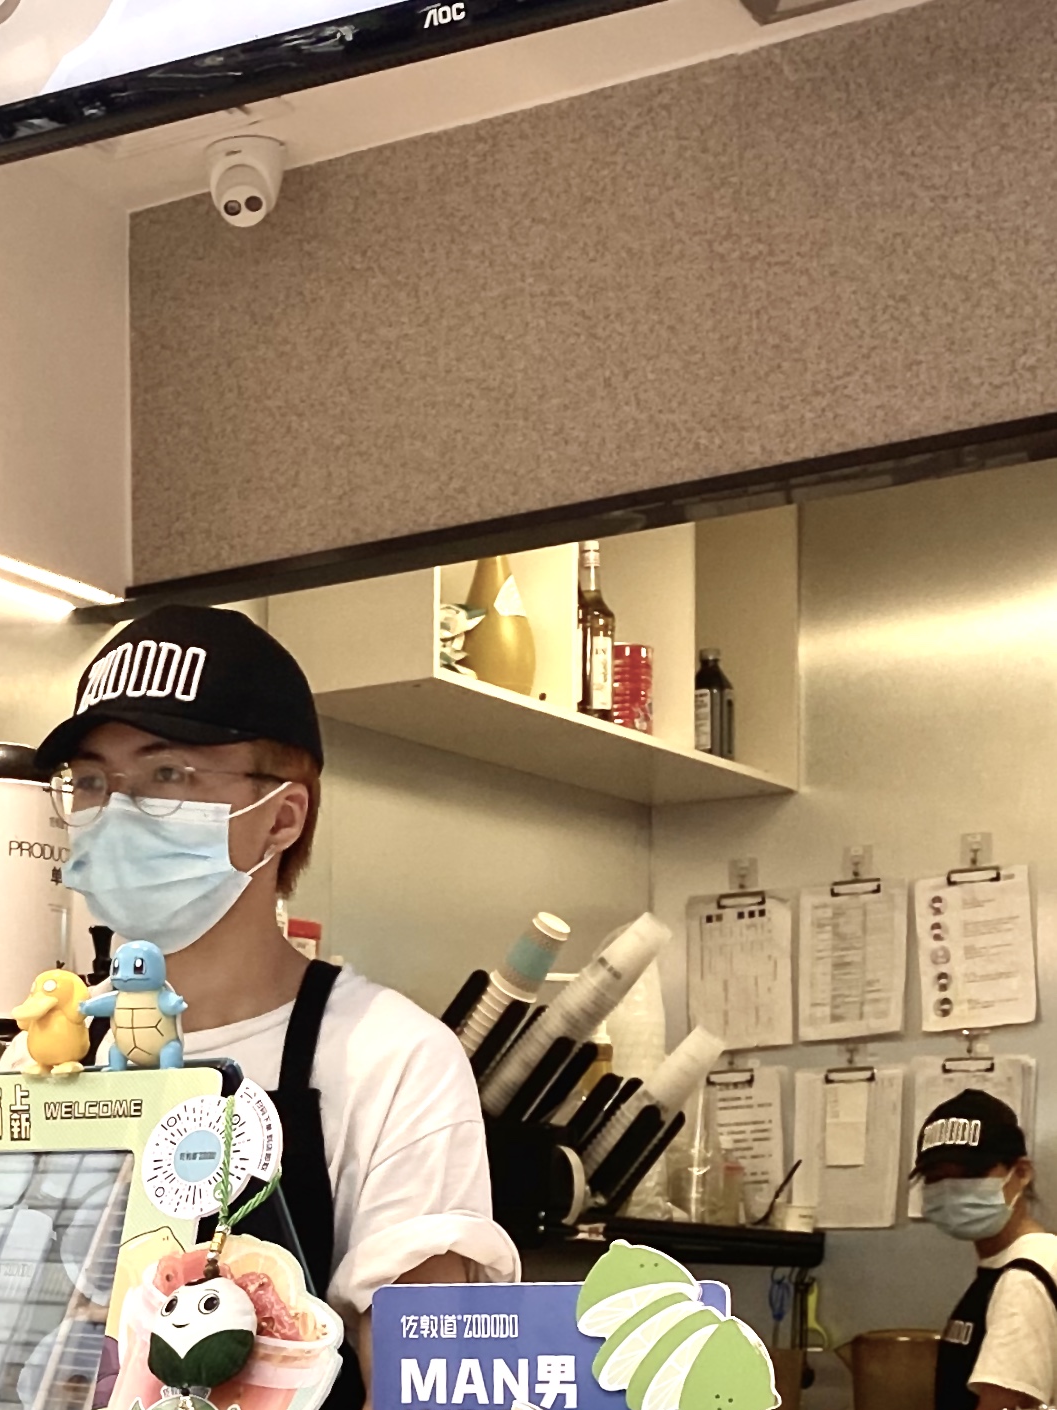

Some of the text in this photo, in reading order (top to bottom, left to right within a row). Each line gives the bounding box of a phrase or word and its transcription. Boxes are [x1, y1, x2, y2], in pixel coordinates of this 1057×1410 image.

[424, 2, 466, 29] AOC
[9, 1084, 31, 1141] 上新
[43, 1099, 143, 1121] WELCOME
[401, 1314, 457, 1339] 佐敦道
[400, 1355, 577, 1409] MAN男
